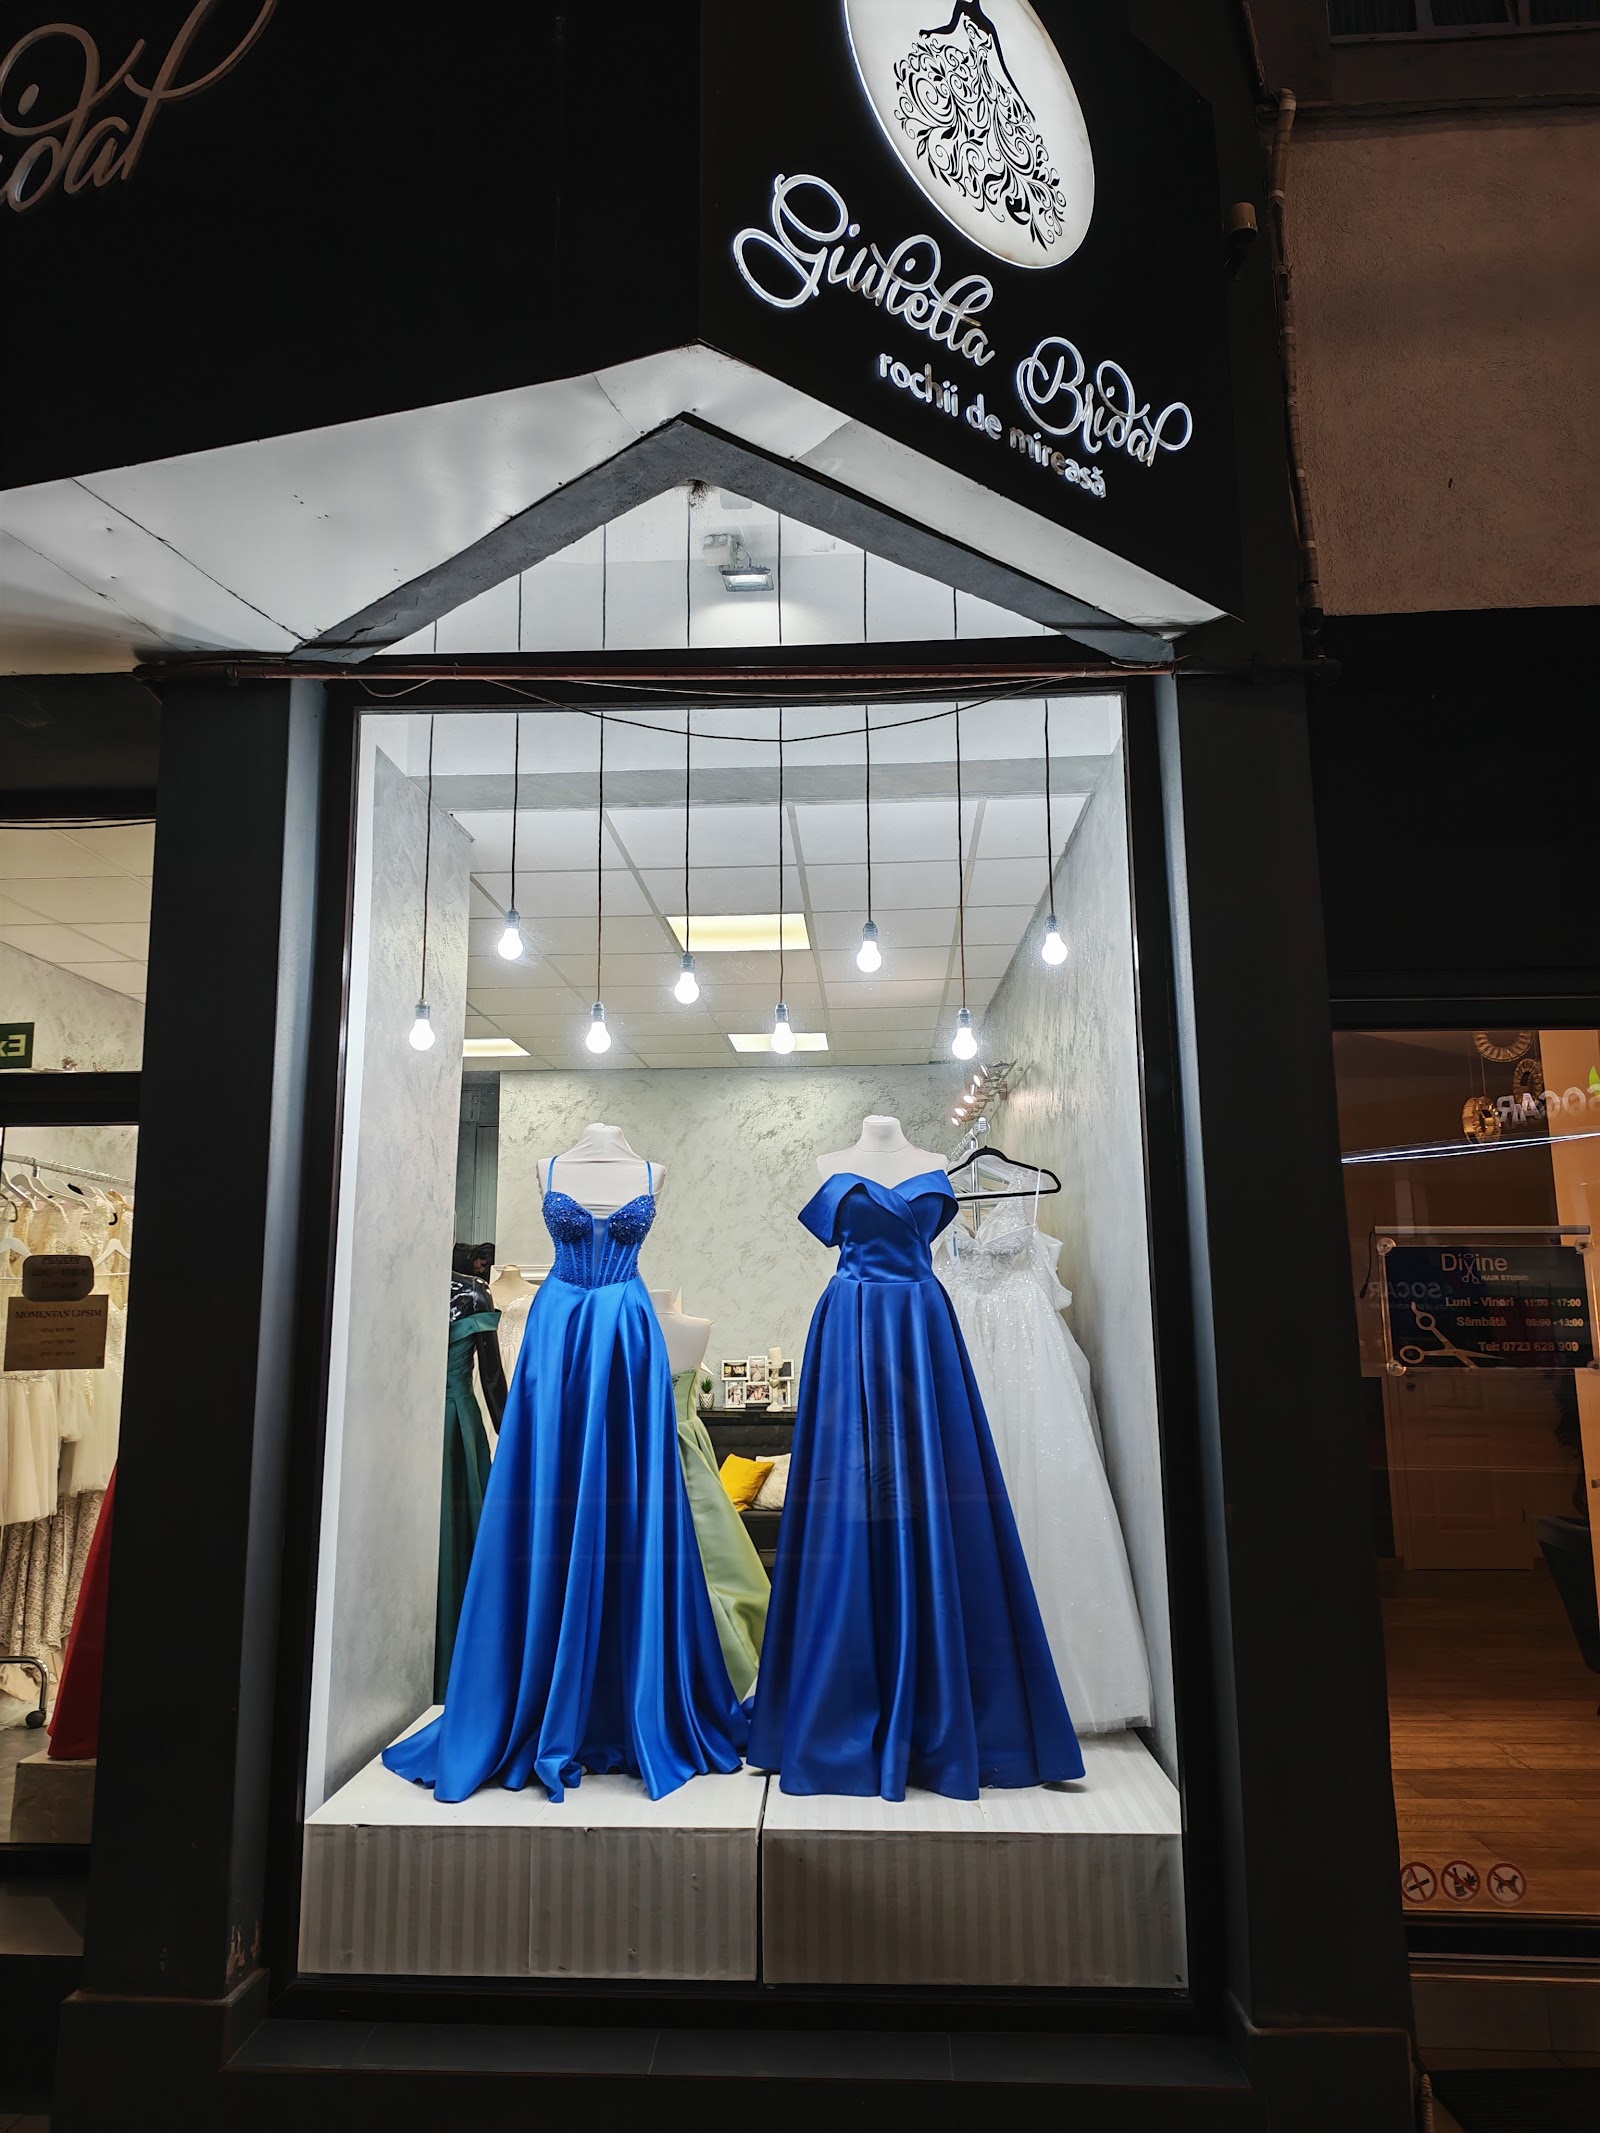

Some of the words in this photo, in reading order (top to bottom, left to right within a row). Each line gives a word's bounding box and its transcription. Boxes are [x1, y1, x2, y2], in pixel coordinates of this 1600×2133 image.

[732, 173, 995, 366] Giulietta
[1016, 336, 1193, 467] Bridal
[878, 350, 960, 418] rochii
[966, 393, 1003, 441] de
[1009, 425, 1107, 499] mireasă
[1441, 1253, 1508, 1275] Divine
[1445, 1297, 1471, 1307] Luni
[1480, 1297, 1514, 1307] Vineri
[1557, 1298, 1582, 1308] 17:00
[1502, 1341, 1531, 1352] 0723
